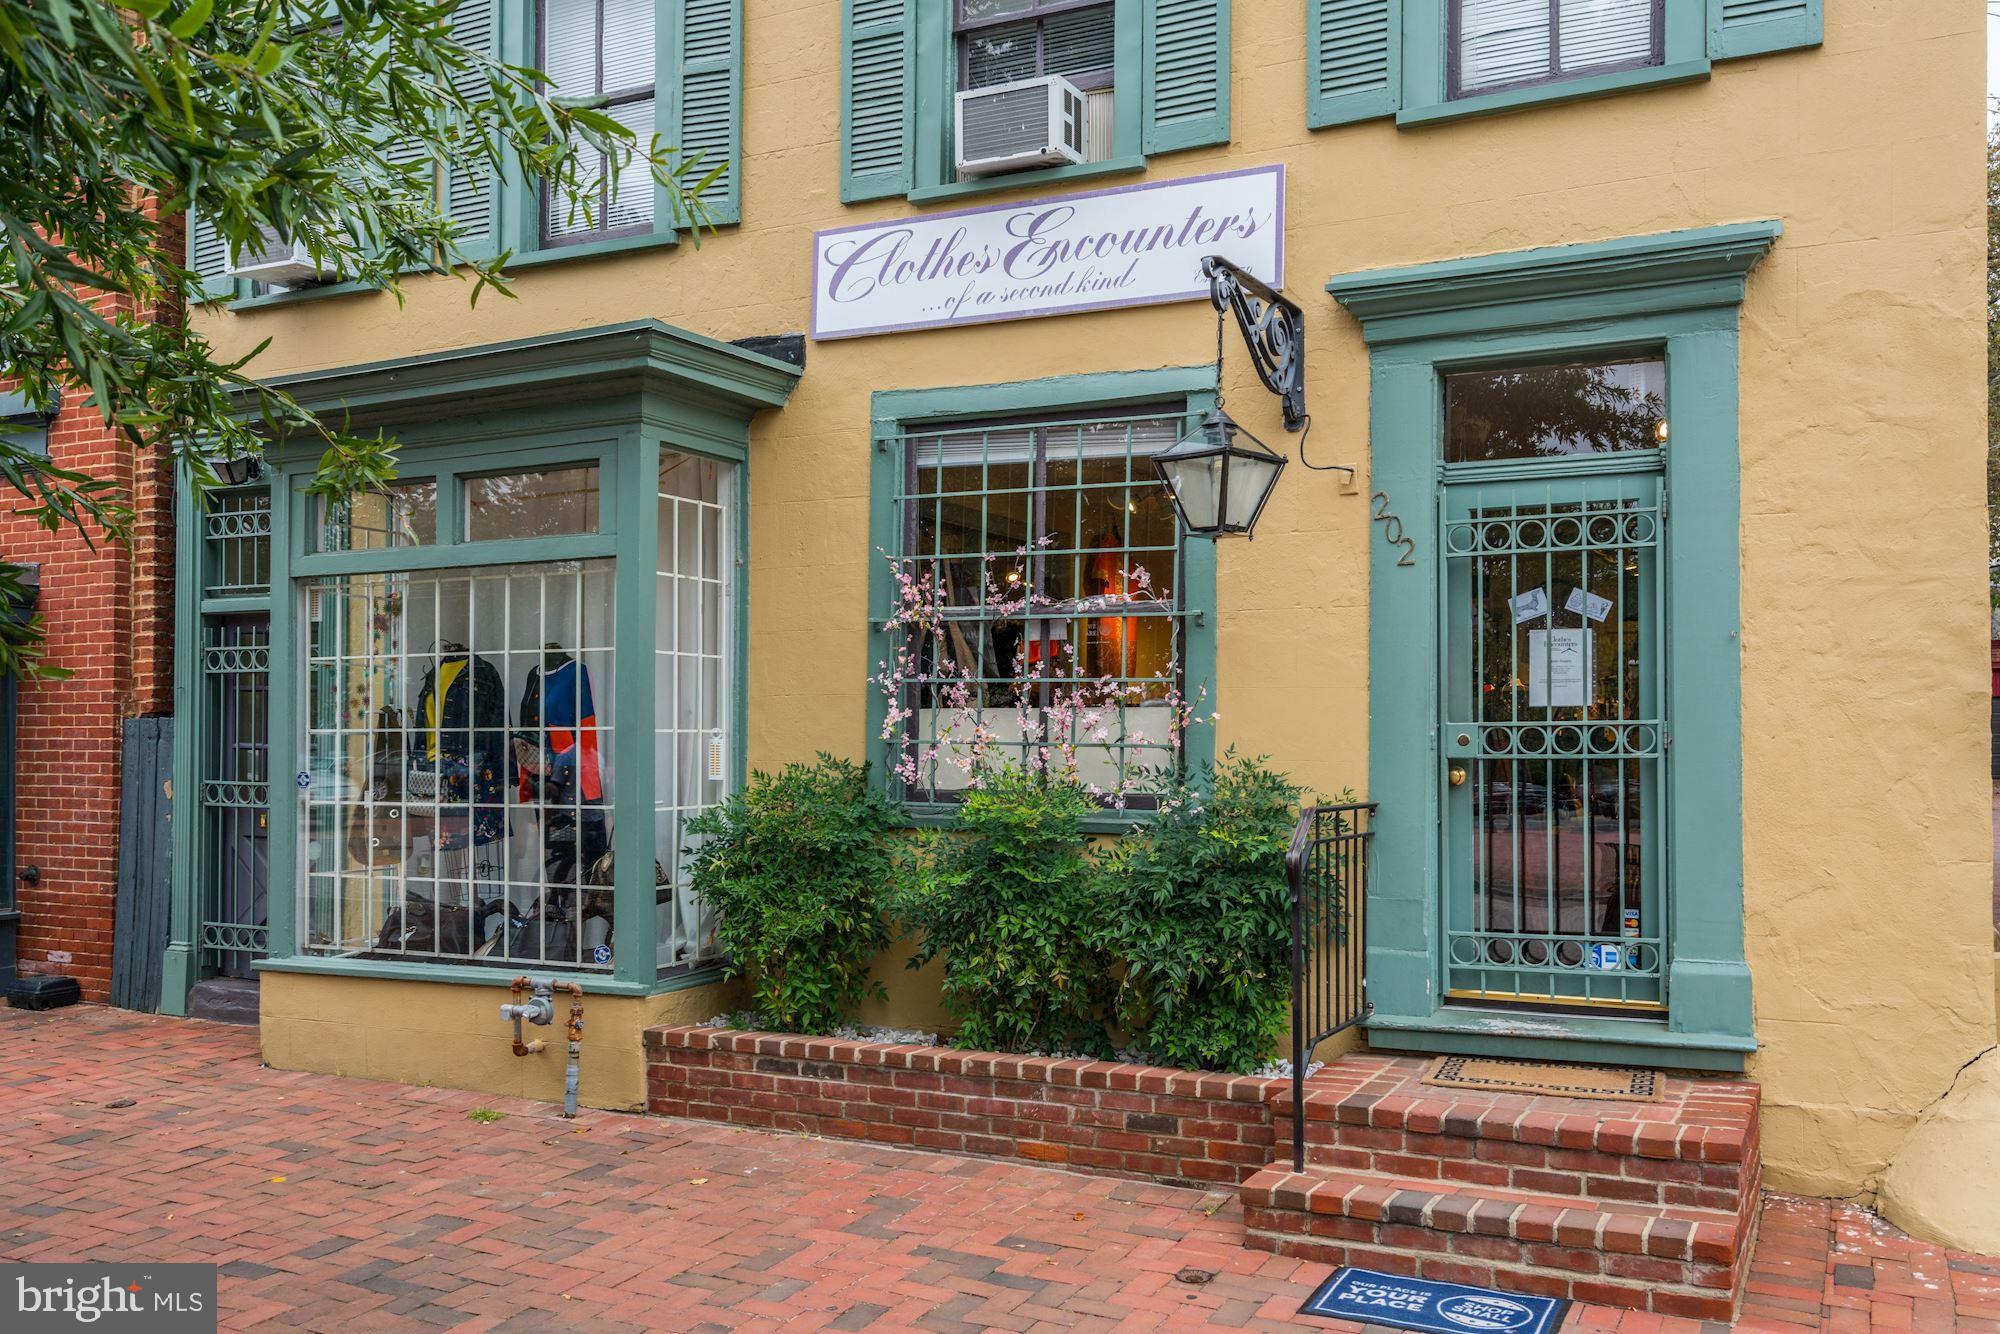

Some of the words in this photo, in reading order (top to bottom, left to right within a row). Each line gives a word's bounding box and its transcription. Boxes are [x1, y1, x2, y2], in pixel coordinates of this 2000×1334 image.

[824, 226, 1001, 303] Clothes
[1003, 206, 1272, 280] Encounters
[976, 291, 996, 305] a
[1000, 271, 1074, 303] second
[1074, 258, 1136, 294] kind
[1371, 491, 1416, 567] 202
[1350, 1284, 1429, 1304] YOUR
[1351, 1280, 1377, 1289] OUR
[1379, 1284, 1418, 1295] PLACE
[1338, 1292, 1425, 1312] PLACE
[1462, 1301, 1516, 1315] SHOP
[1451, 1305, 1511, 1323] SMALL
